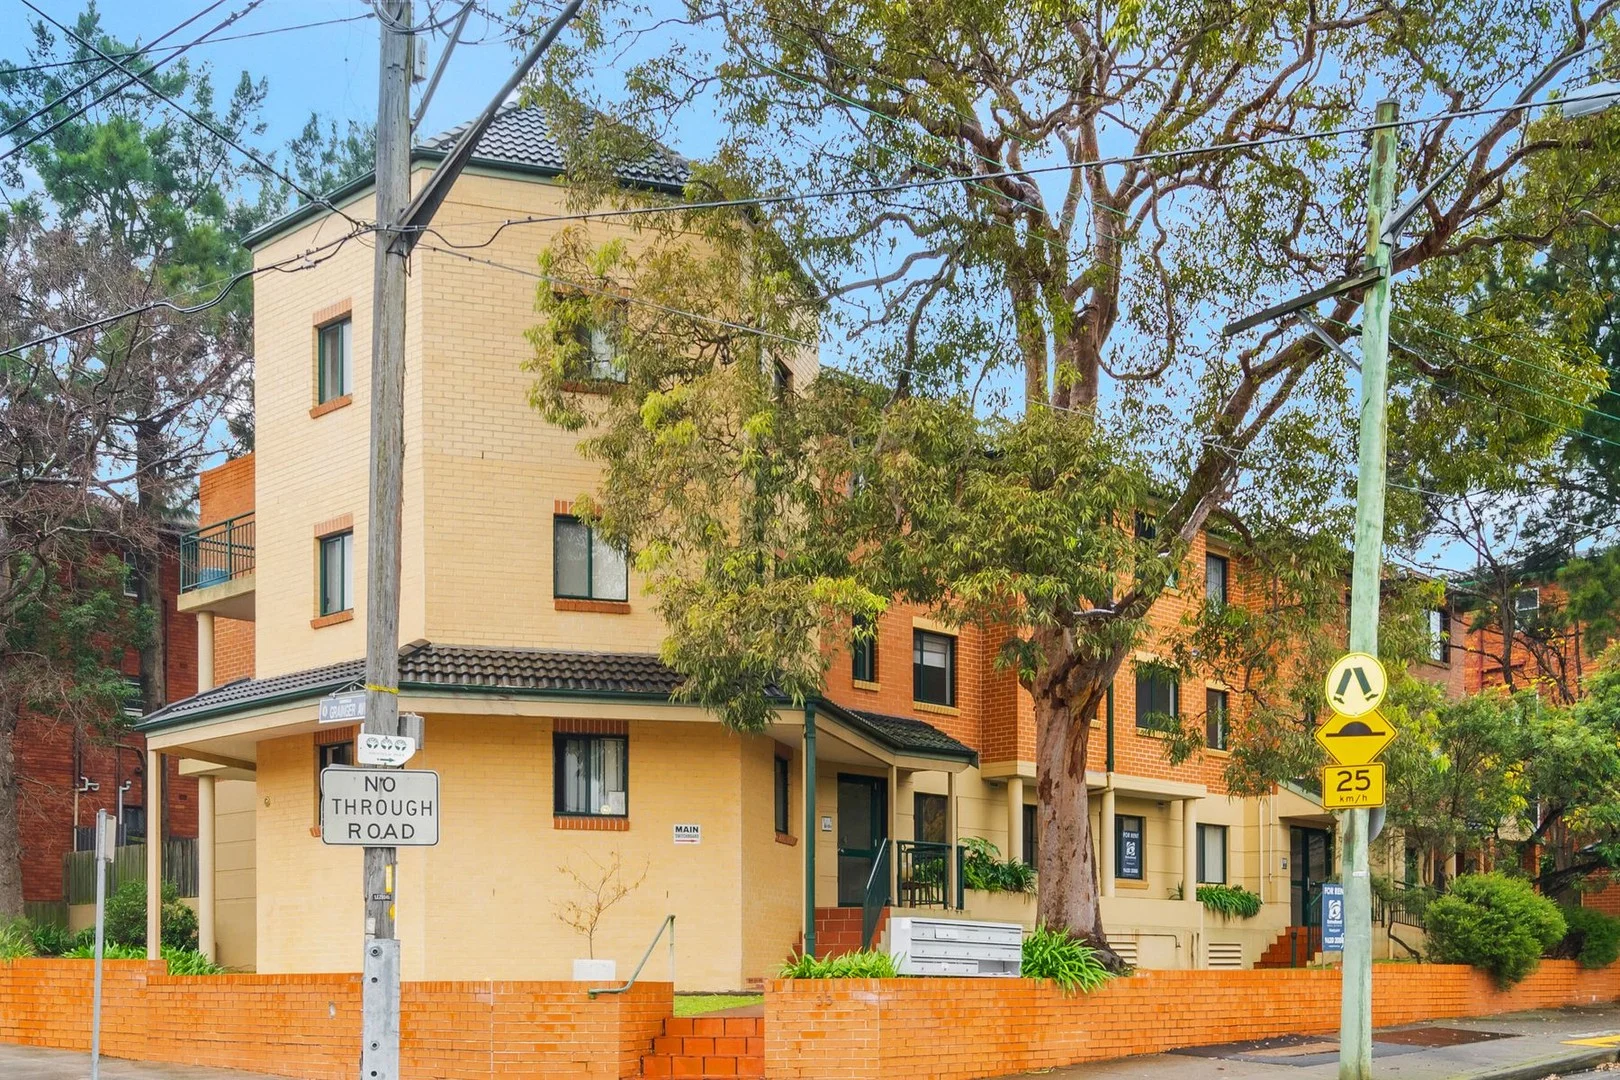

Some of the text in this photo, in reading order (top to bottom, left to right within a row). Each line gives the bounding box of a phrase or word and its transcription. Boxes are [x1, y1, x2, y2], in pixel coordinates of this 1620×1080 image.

[365, 776, 396, 793] NO
[1336, 769, 1371, 792] 25
[332, 798, 433, 816] THROUGH
[1339, 794, 1368, 804] km/h
[348, 823, 415, 840] ROAD
[1324, 887, 1344, 895] FOR REN
